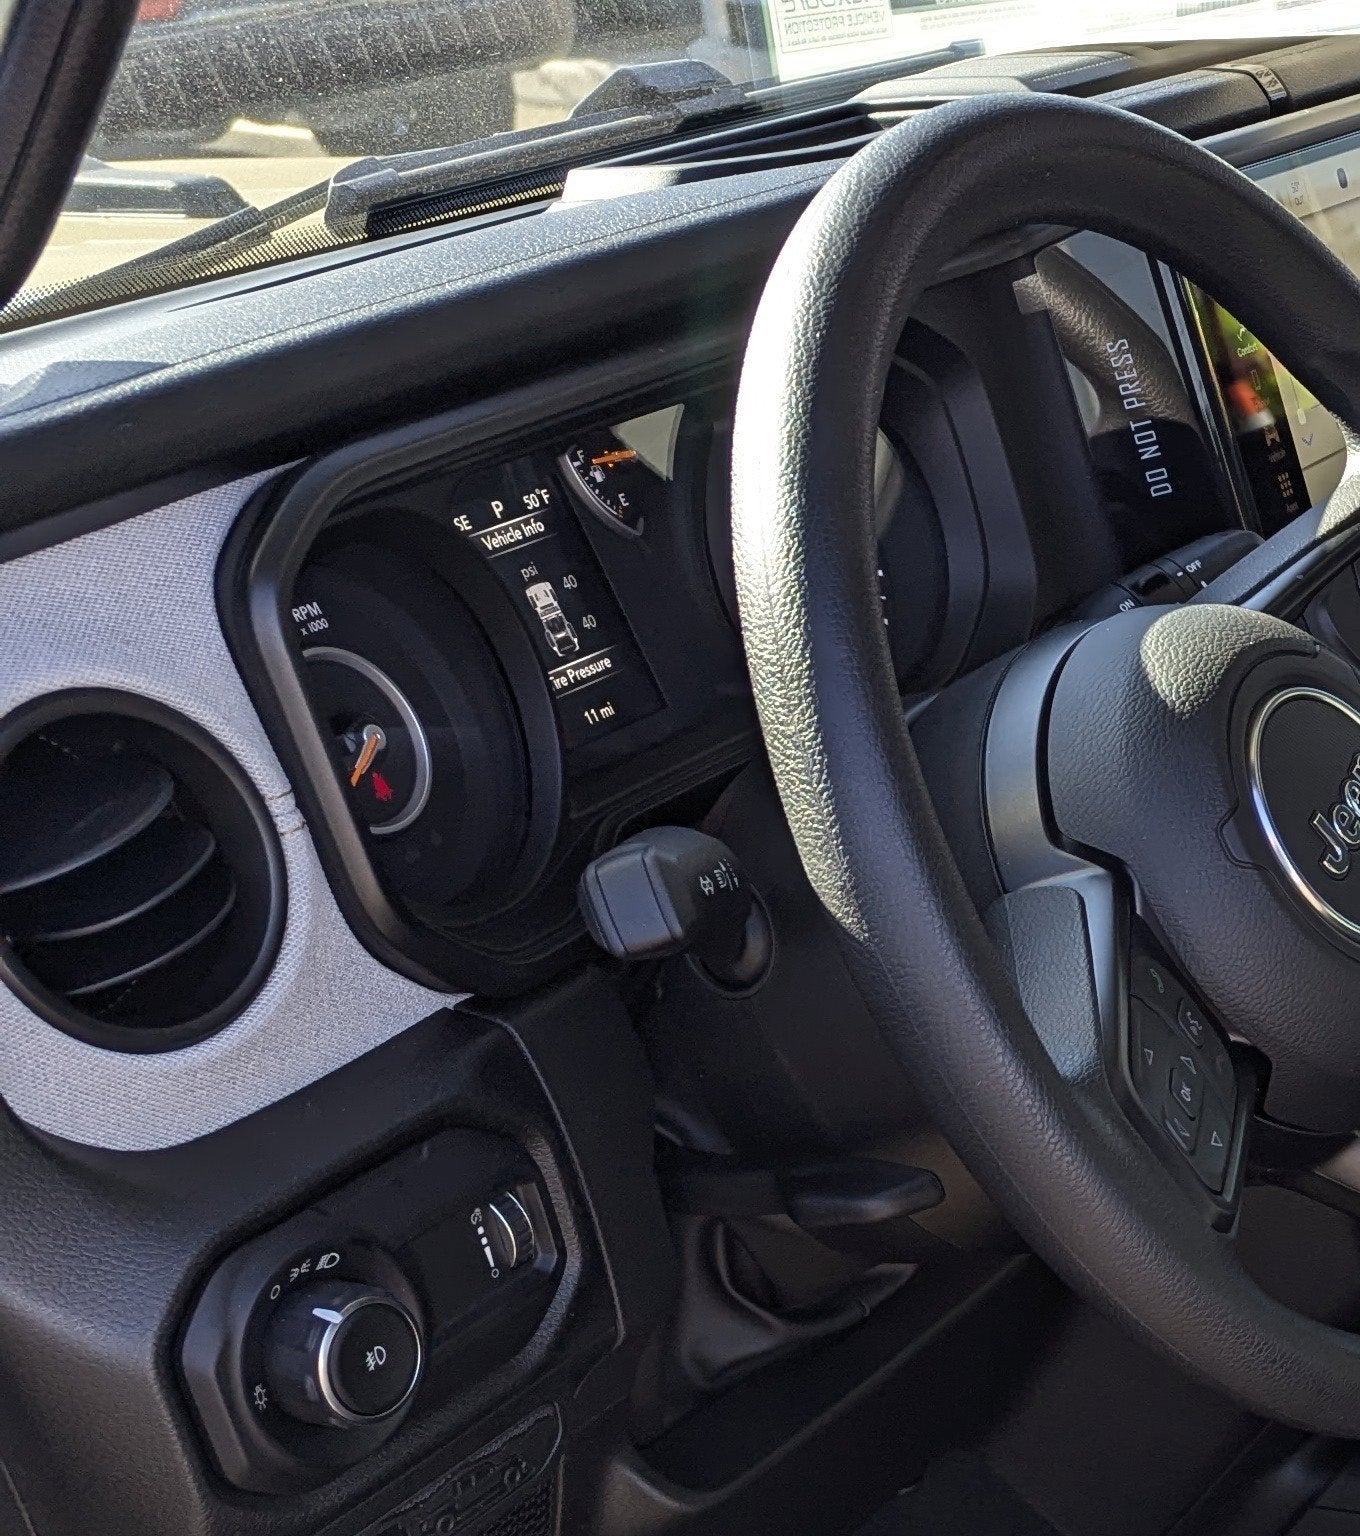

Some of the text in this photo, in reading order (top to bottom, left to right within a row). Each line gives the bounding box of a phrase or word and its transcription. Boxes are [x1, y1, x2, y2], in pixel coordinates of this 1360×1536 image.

[1106, 338, 1173, 497] DO NOT PRESS
[618, 492, 629, 507] E
[453, 515, 472, 531] SE
[491, 501, 503, 518] P
[481, 518, 545, 550] Vehicle Info
[520, 561, 539, 581] psi
[1185, 559, 1202, 572] OFF
[563, 574, 578, 590] 40
[292, 601, 322, 622] RPM
[1119, 598, 1135, 612] ON
[307, 618, 329, 633] 1000
[582, 614, 597, 630] 40
[567, 657, 612, 684] Pressure
[584, 701, 616, 725] 11 mi
